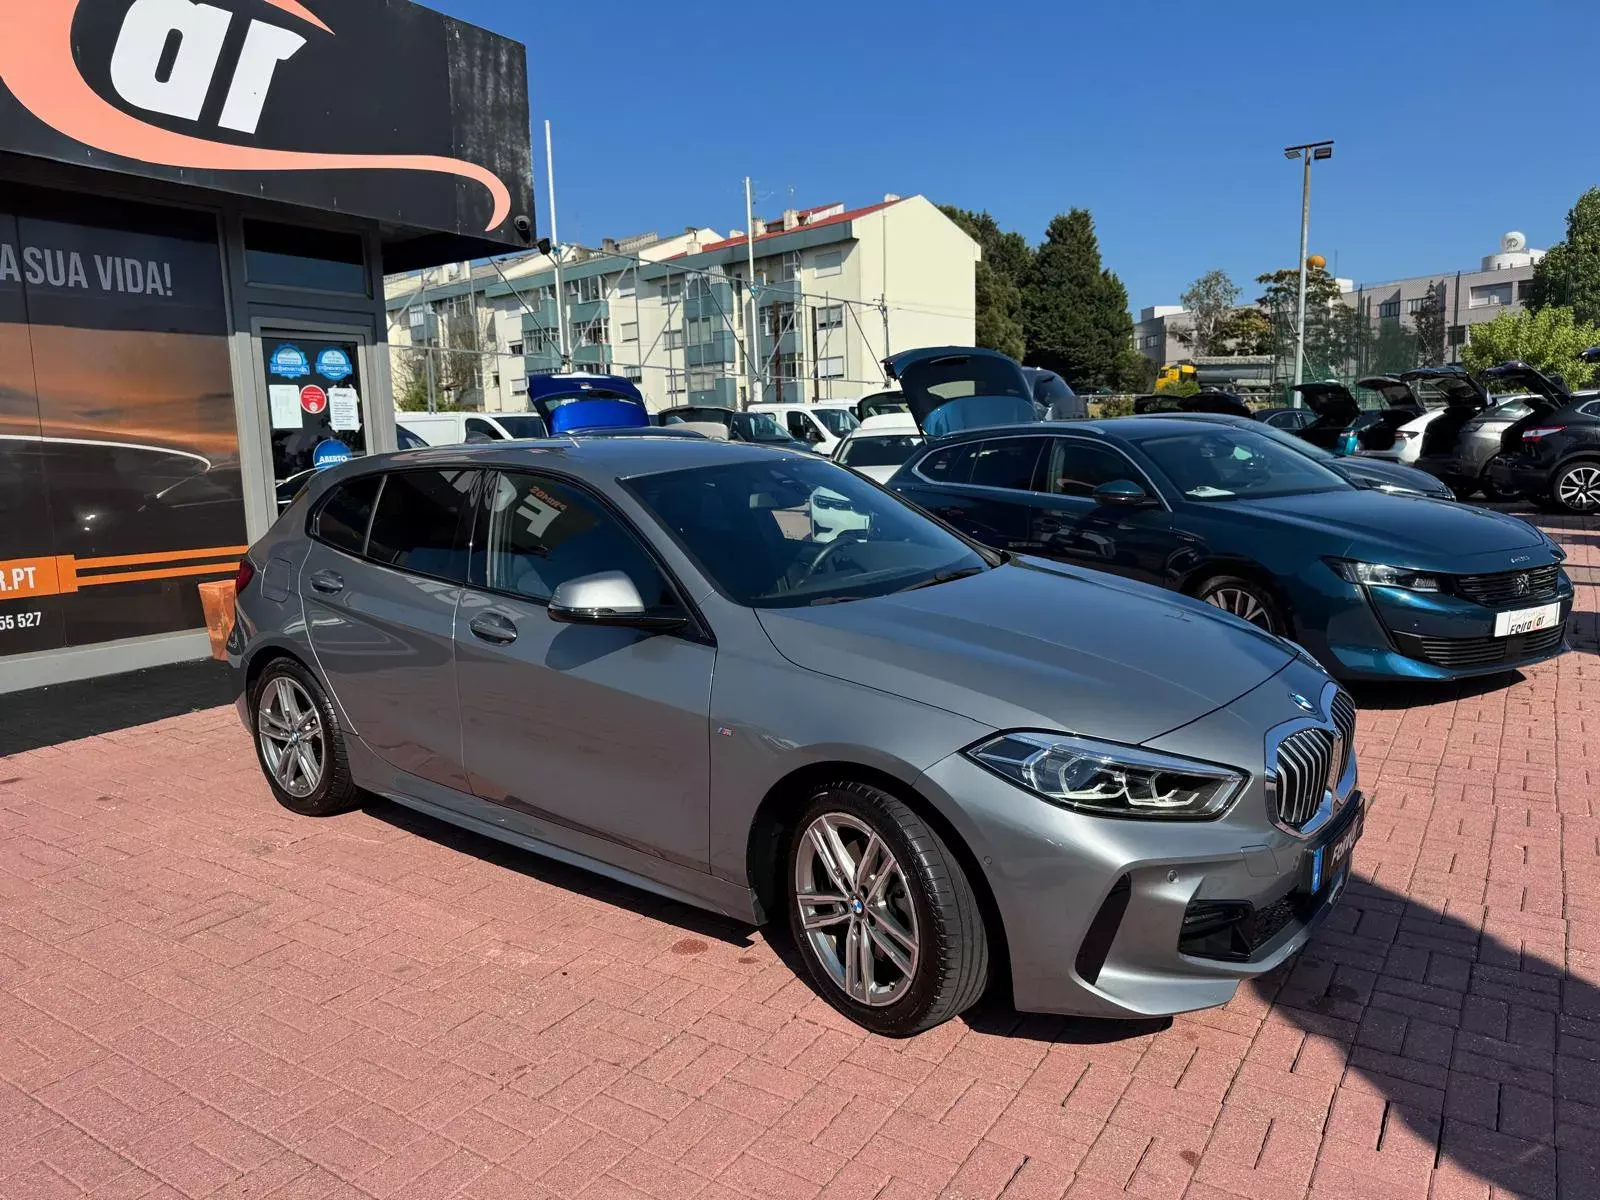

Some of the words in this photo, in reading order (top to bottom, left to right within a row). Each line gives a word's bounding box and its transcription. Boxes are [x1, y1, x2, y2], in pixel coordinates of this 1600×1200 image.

[93, 254, 173, 296] VIDA!
[319, 455, 348, 463] ABERTO
[17, 611, 42, 628] 527
